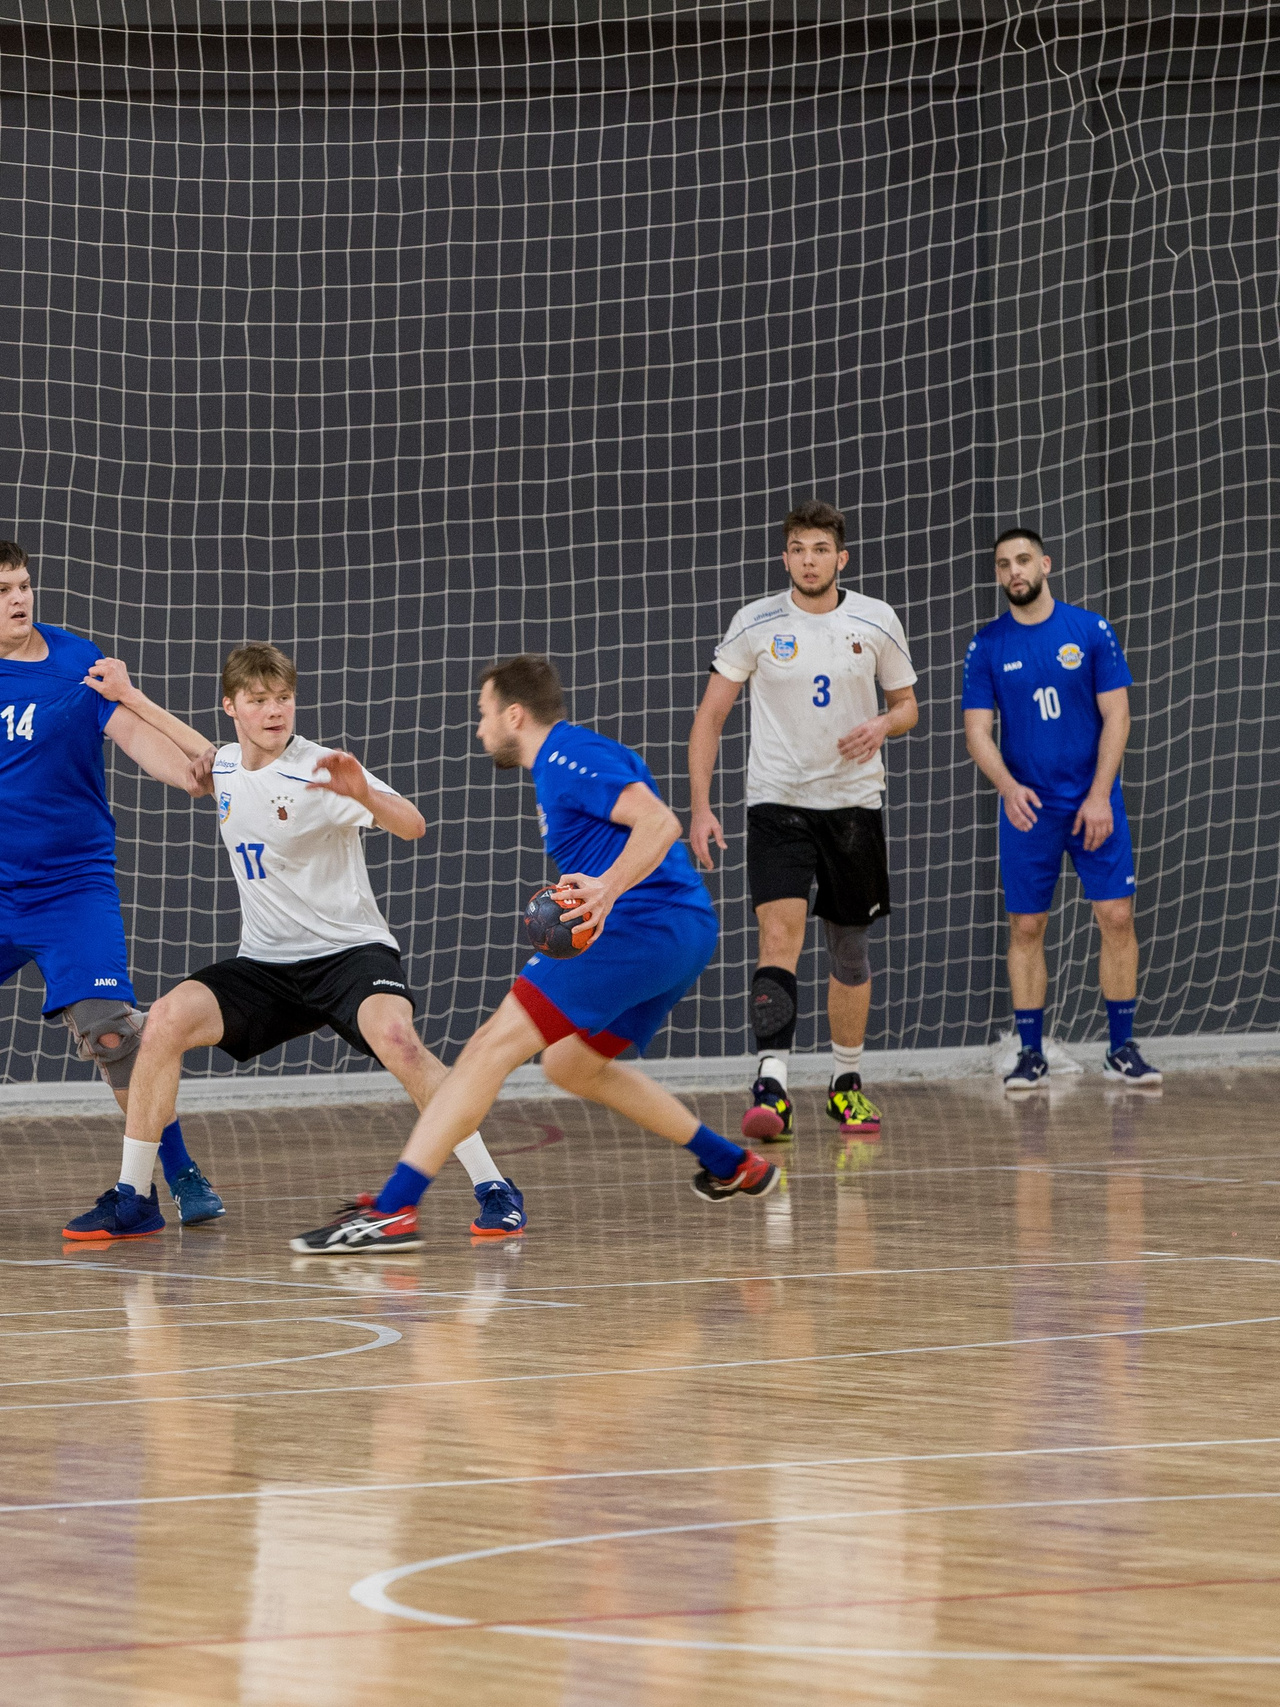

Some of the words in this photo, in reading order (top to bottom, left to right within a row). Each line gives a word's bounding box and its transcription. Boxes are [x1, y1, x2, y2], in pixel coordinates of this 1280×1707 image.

[812, 674, 831, 708] 3
[1032, 686, 1061, 721] 10
[0, 703, 37, 741] 14
[215, 760, 238, 769] uhlspor
[235, 842, 267, 880] 17
[94, 978, 118, 987] JAKO
[372, 979, 405, 990] uhlsport
